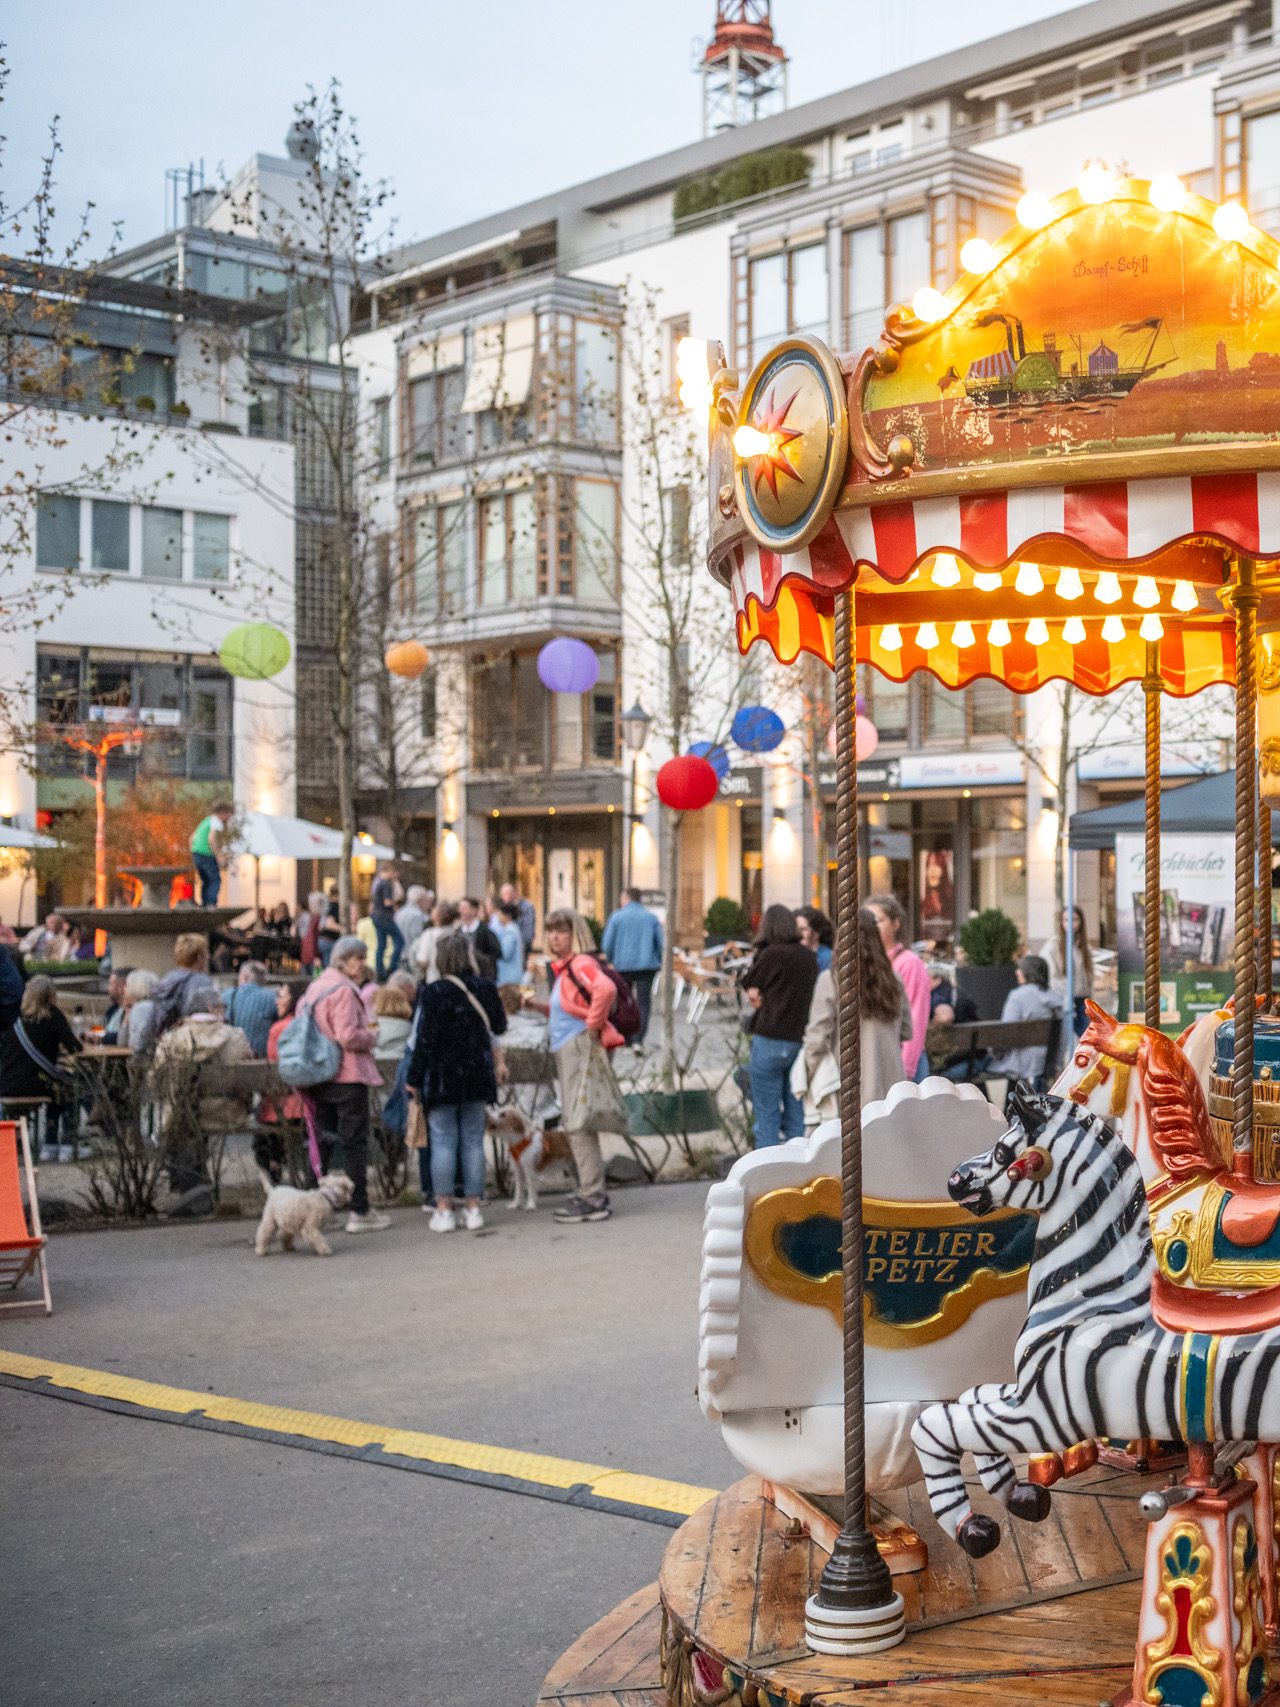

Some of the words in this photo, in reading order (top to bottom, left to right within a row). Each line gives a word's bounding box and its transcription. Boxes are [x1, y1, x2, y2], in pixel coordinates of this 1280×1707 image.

[1129, 850, 1226, 872] Kchbücher
[837, 1230, 997, 1256] TELIER
[865, 1259, 960, 1283] PETZ
